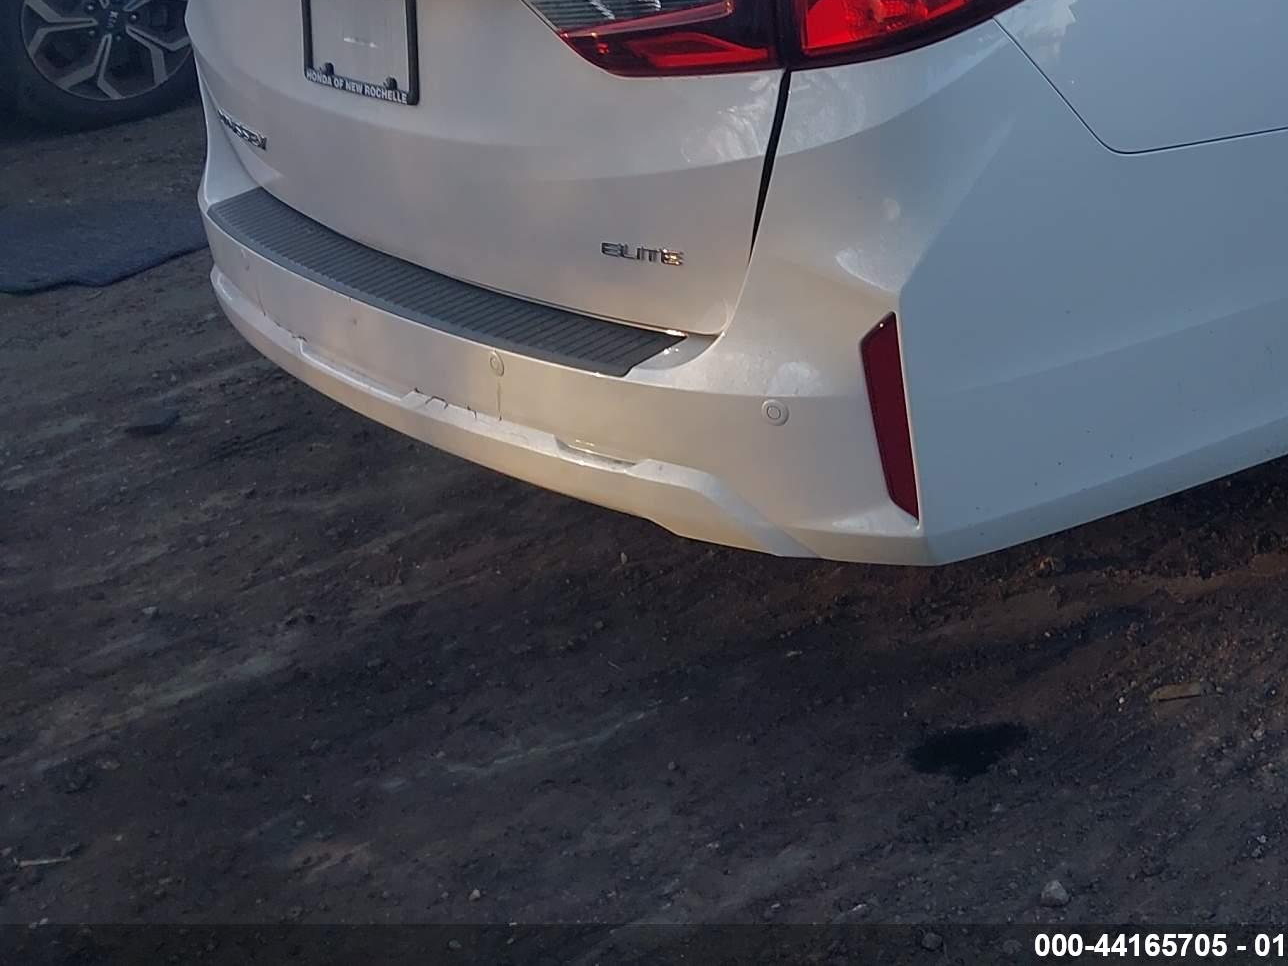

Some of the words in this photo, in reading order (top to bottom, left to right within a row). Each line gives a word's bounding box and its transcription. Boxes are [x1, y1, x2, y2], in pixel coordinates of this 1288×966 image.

[306, 69, 333, 86] HONDA
[335, 77, 344, 89] OF
[346, 81, 363, 95] NEW
[365, 84, 408, 104] ROCHELLE
[602, 242, 684, 265] ELITE
